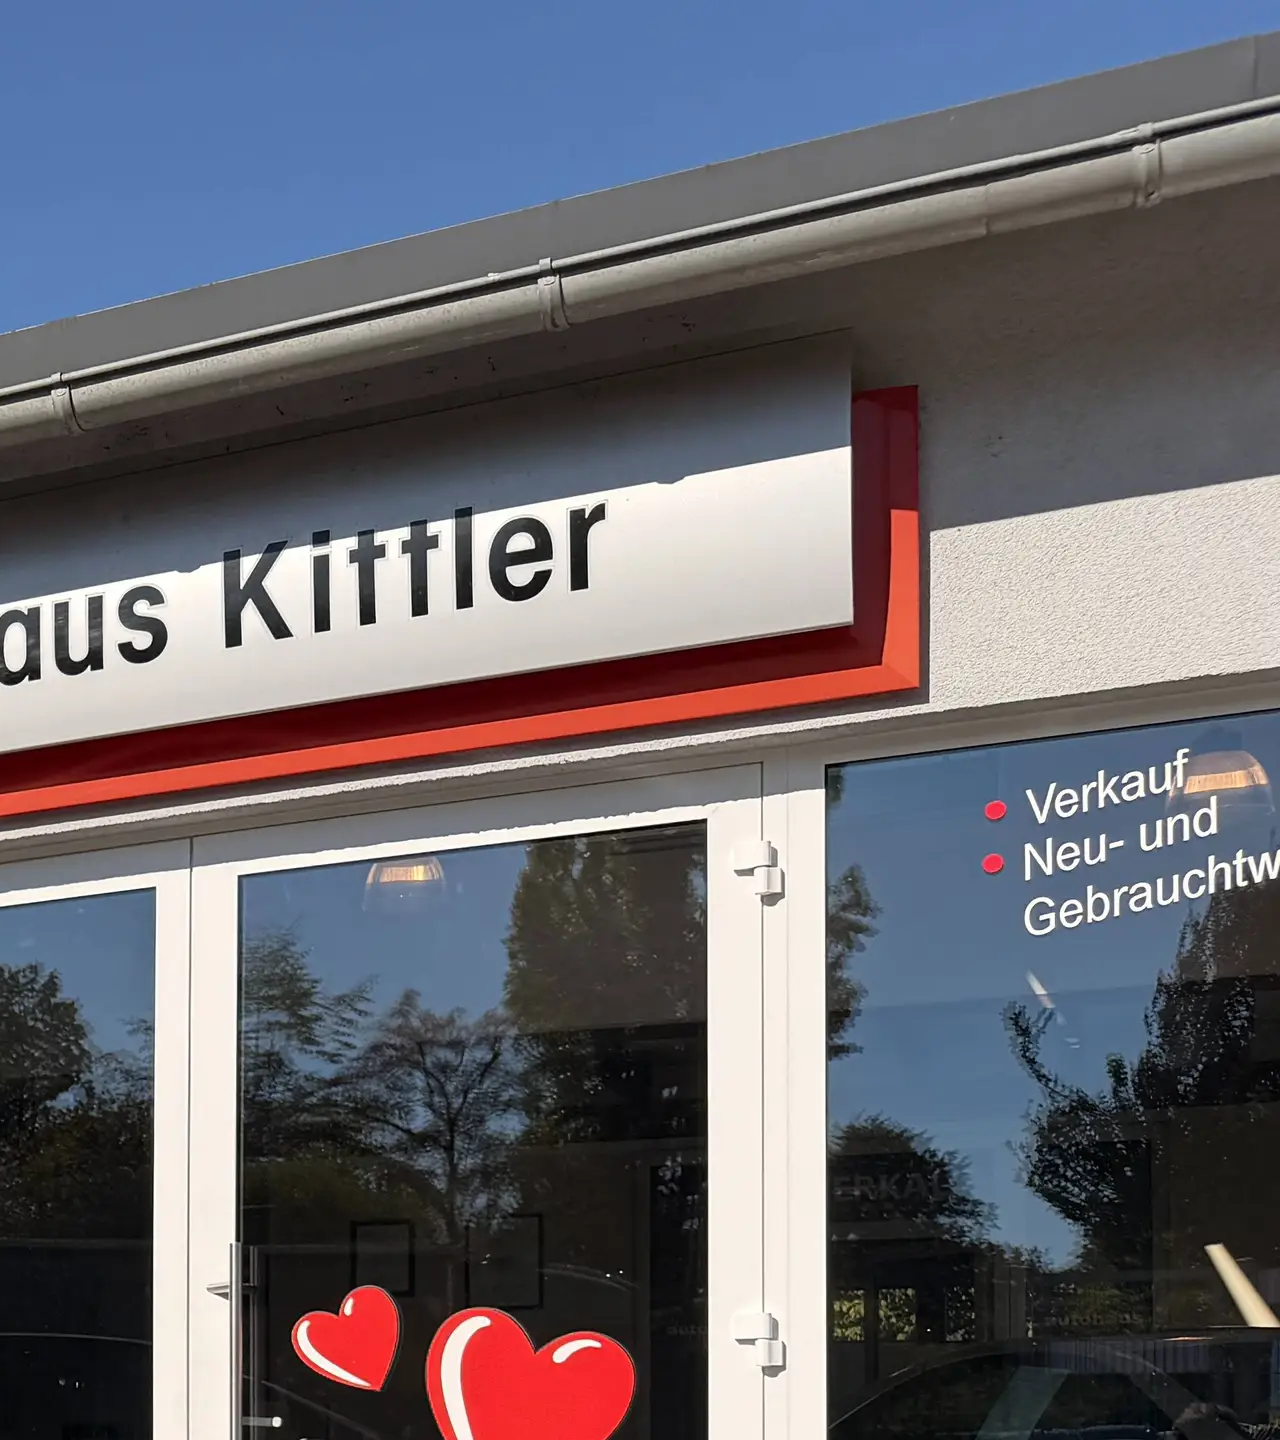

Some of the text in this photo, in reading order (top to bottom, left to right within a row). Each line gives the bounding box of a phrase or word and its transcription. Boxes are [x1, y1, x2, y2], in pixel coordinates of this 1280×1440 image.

[222, 498, 609, 650] Kittler
[1025, 748, 1189, 824] Verkauf
[1024, 796, 1218, 881] Neu- und
